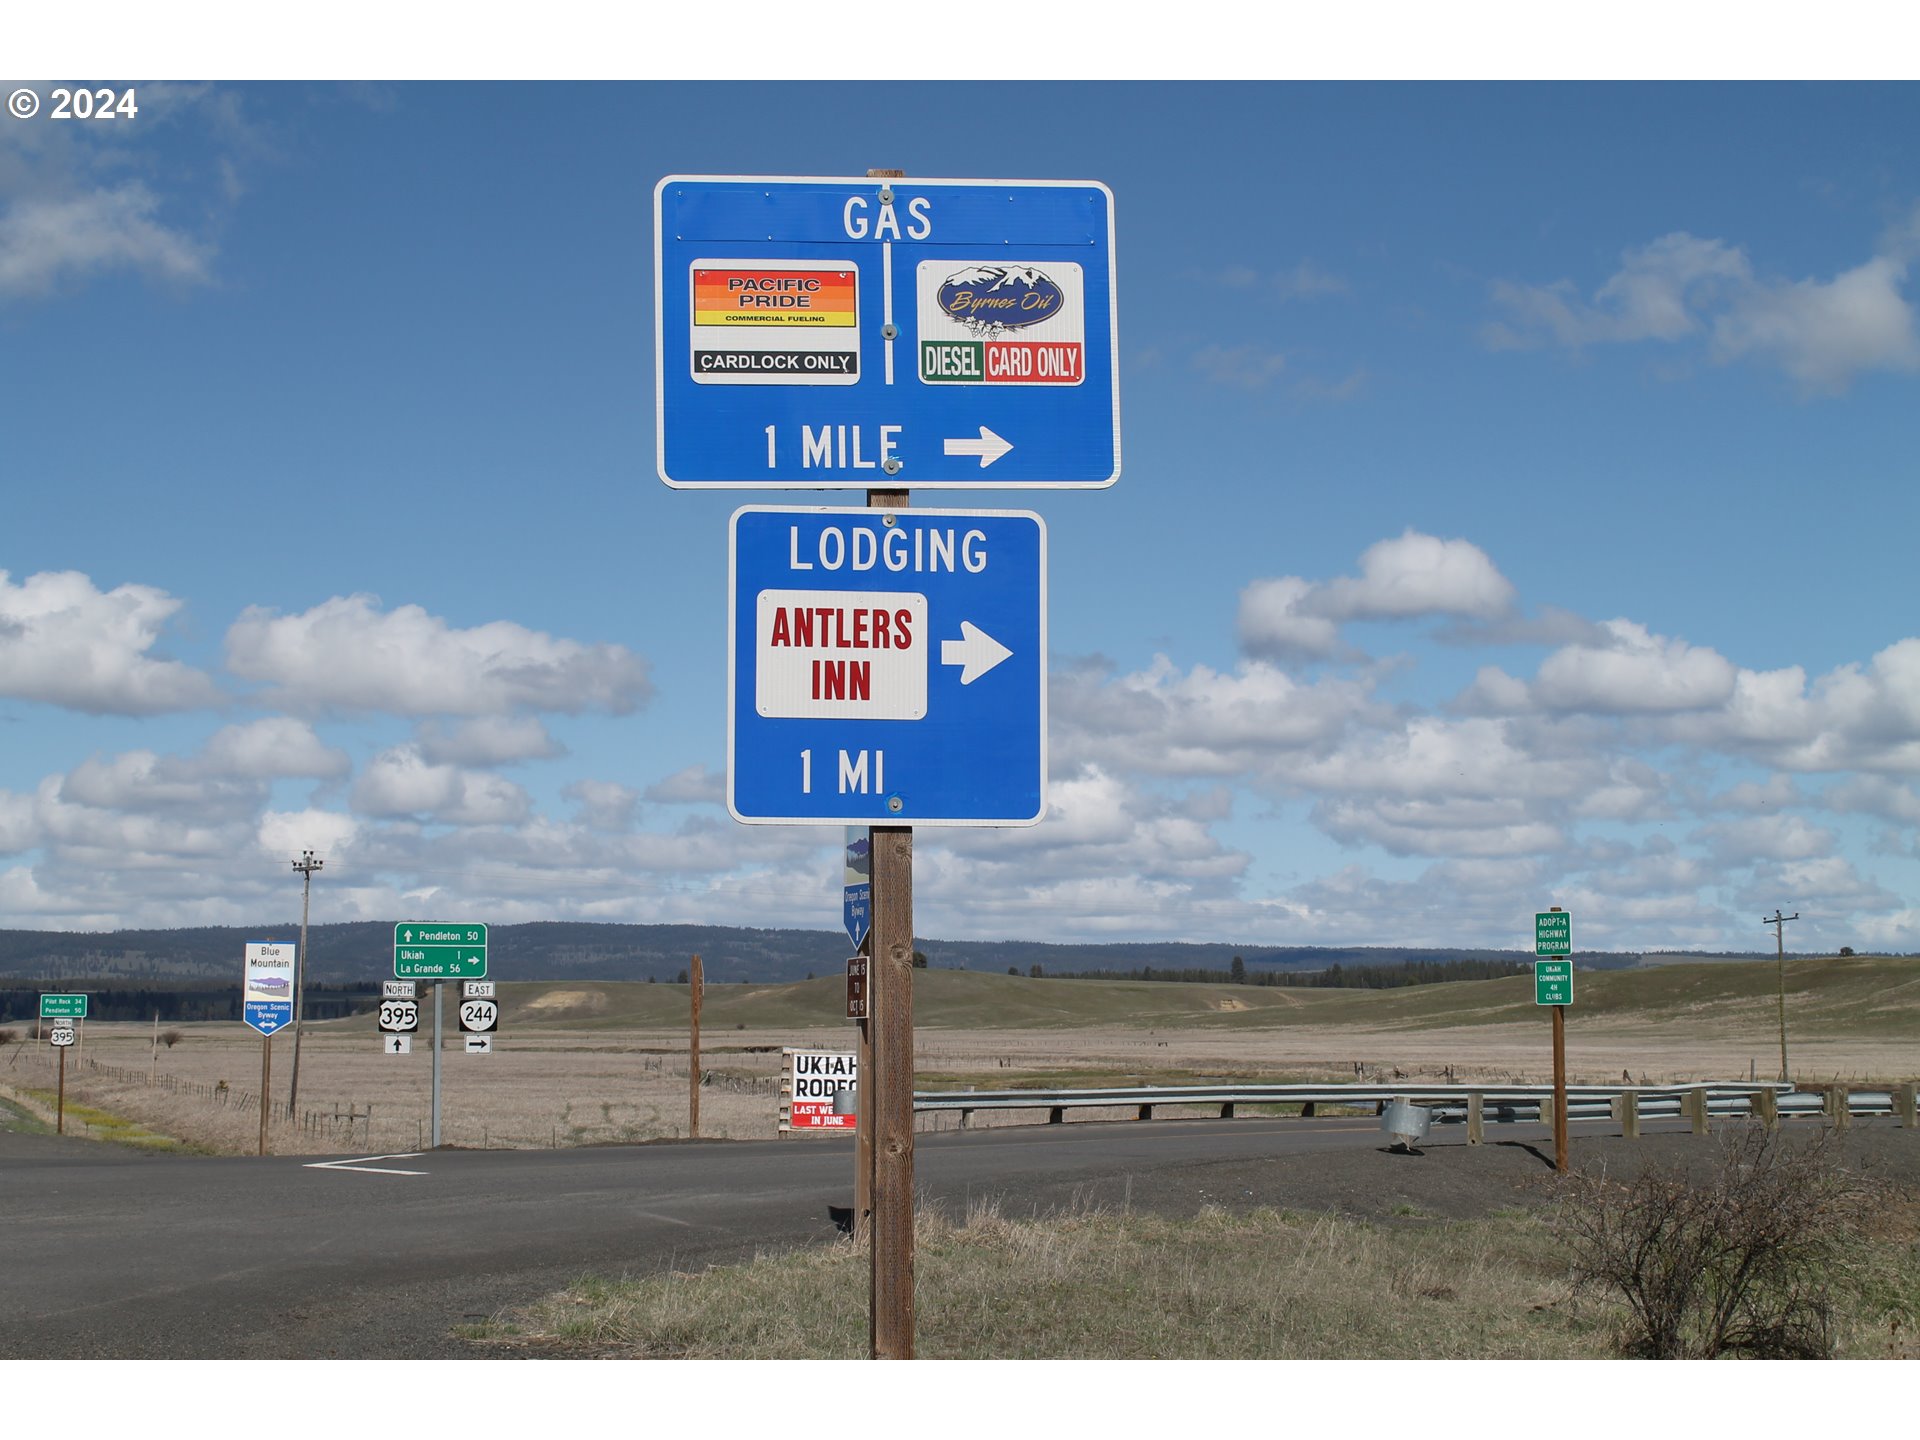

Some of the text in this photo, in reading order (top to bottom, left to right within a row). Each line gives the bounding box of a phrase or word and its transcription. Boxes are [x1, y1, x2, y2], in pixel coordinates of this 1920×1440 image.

[843, 196, 932, 240] GAS
[727, 277, 821, 293] PACIFIC
[738, 294, 810, 308] PRIDE
[949, 290, 1054, 318] Byrnes Oil
[725, 314, 825, 323] COMMERCIAL FUELING
[701, 354, 850, 371] CARDLOCK ONLY
[926, 346, 1078, 377] DIESEL CARD ONLY
[765, 425, 904, 469] 1 MILE
[790, 526, 987, 573] LODGING
[771, 607, 912, 649] ANTLERS
[811, 660, 871, 701] INN
[800, 749, 884, 794] 1 MI
[1539, 918, 1566, 926] ADOPT-A
[419, 932, 478, 940] Pendleton 50
[1538, 930, 1567, 938] HIGHWAY
[261, 947, 280, 956] Blue
[1538, 942, 1569, 950] PROGRAM
[401, 950, 424, 959] Ukiah
[250, 959, 290, 968] Mountain
[401, 964, 461, 973] La Grande 56
[849, 964, 860, 976] JUNE
[386, 984, 413, 995] NORTH
[468, 984, 490, 994] EAST
[382, 1008, 415, 1025] 395
[466, 1006, 492, 1021] 244
[53, 1032, 72, 1041] 395
[796, 1056, 856, 1074] UKIAH
[794, 1106, 816, 1114] LAST
[823, 1116, 844, 1126] JUNE
